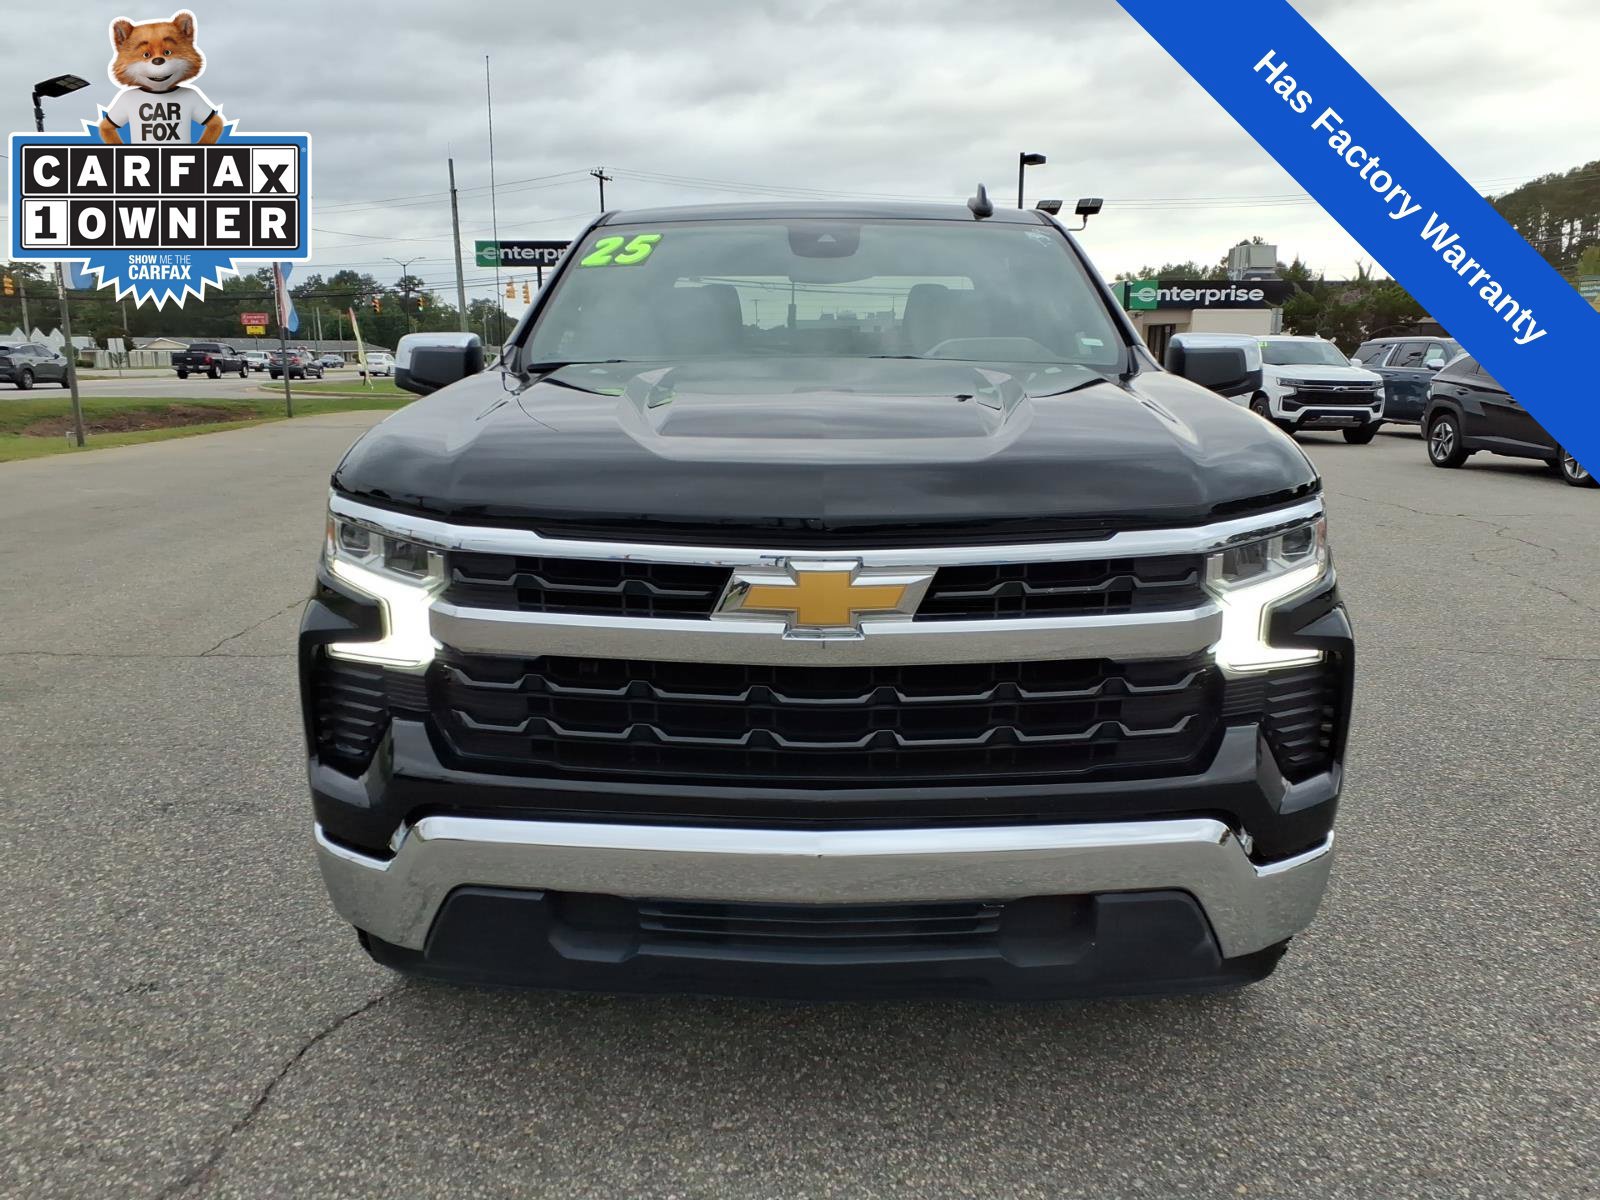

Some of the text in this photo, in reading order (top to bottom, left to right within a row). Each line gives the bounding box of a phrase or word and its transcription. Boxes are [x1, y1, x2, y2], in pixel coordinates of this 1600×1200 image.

[477, 246, 569, 263] enterpr
[580, 233, 662, 267] 25
[1132, 285, 1264, 305] enterprise
